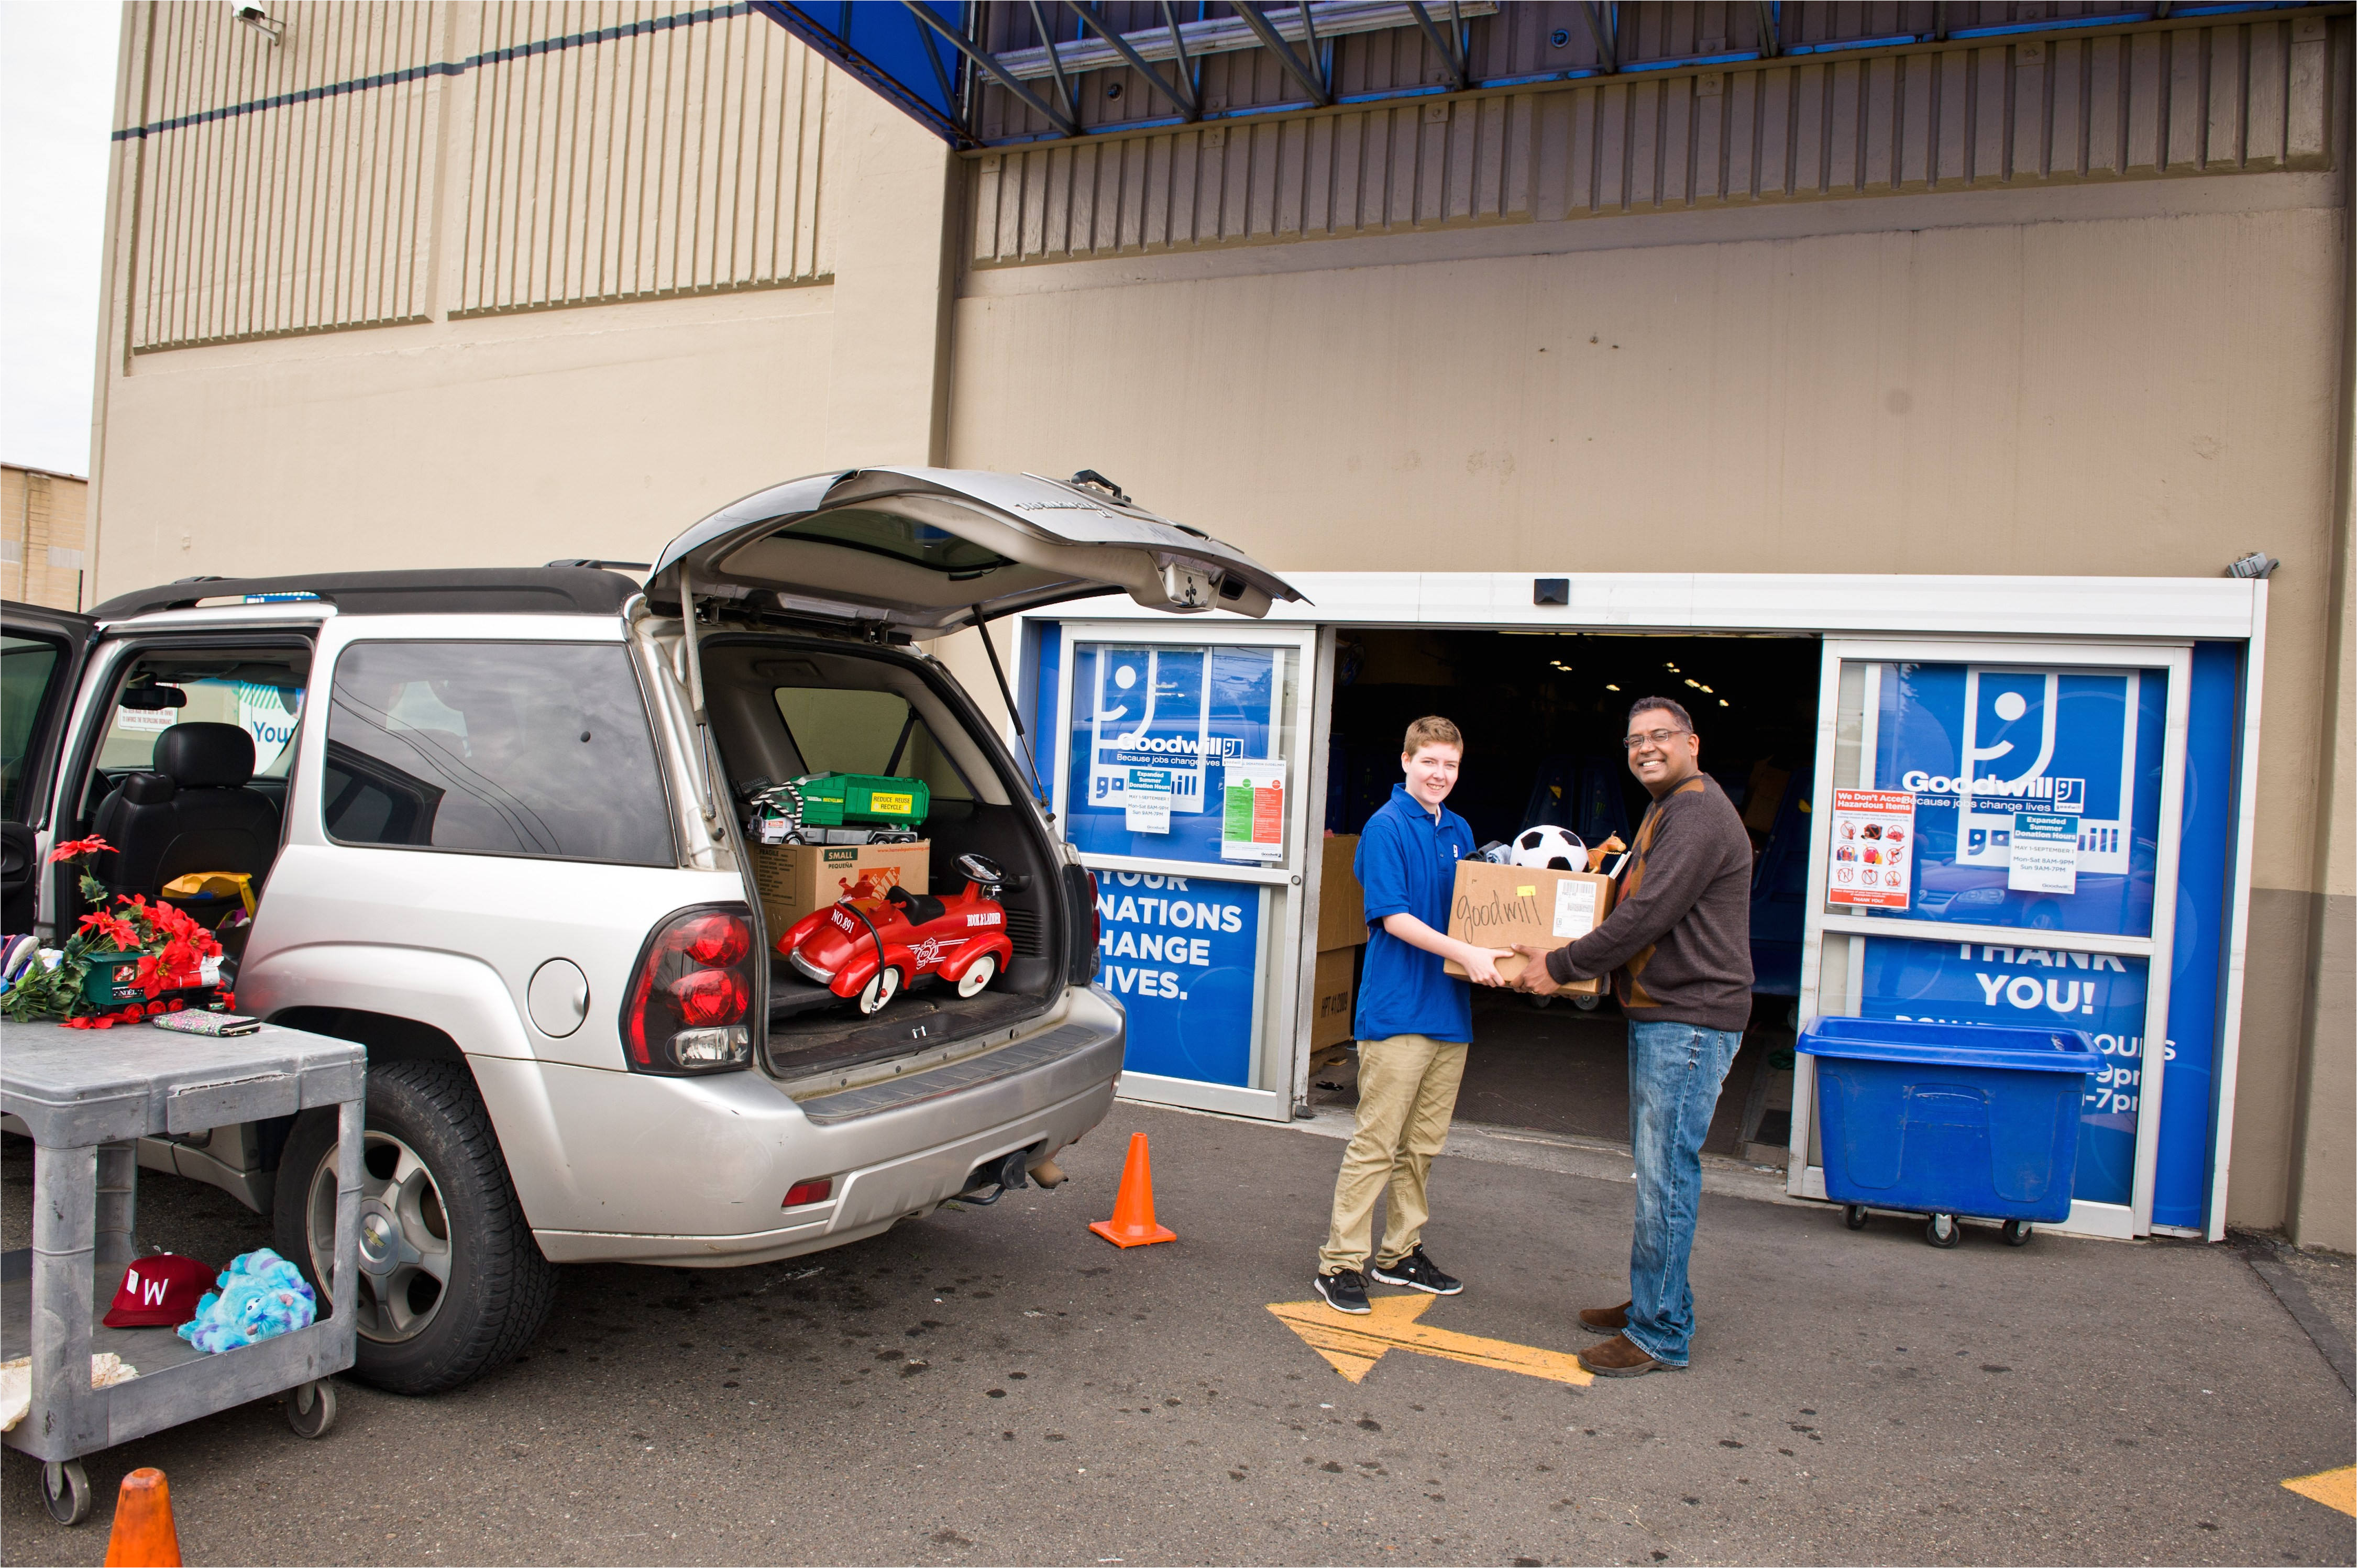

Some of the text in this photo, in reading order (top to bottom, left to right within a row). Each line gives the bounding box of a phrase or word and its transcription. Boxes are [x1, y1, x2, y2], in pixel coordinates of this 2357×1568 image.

[254, 721, 294, 743] You
[1118, 733, 1221, 755] Goodwill
[1117, 753, 1150, 763] Because
[1152, 756, 1169, 764] jobs
[1171, 757, 1199, 767] change
[1902, 770, 2053, 798] Goodwill
[1837, 800, 1884, 809] Hazardous
[1901, 796, 2051, 812] Because jobs change lives
[2026, 816, 2066, 825] Expanded
[828, 851, 853, 860] SMALL
[2042, 857, 2074, 866] 8AM-9PM
[831, 909, 855, 934] NO.891
[1096, 893, 1242, 933] NATIONS
[1457, 890, 1542, 944] goodwill
[1099, 930, 1210, 966] HANGE
[1094, 965, 1188, 1000] IVES.
[1975, 973, 2095, 1014] YOU!
[145, 1278, 169, 1306] W
